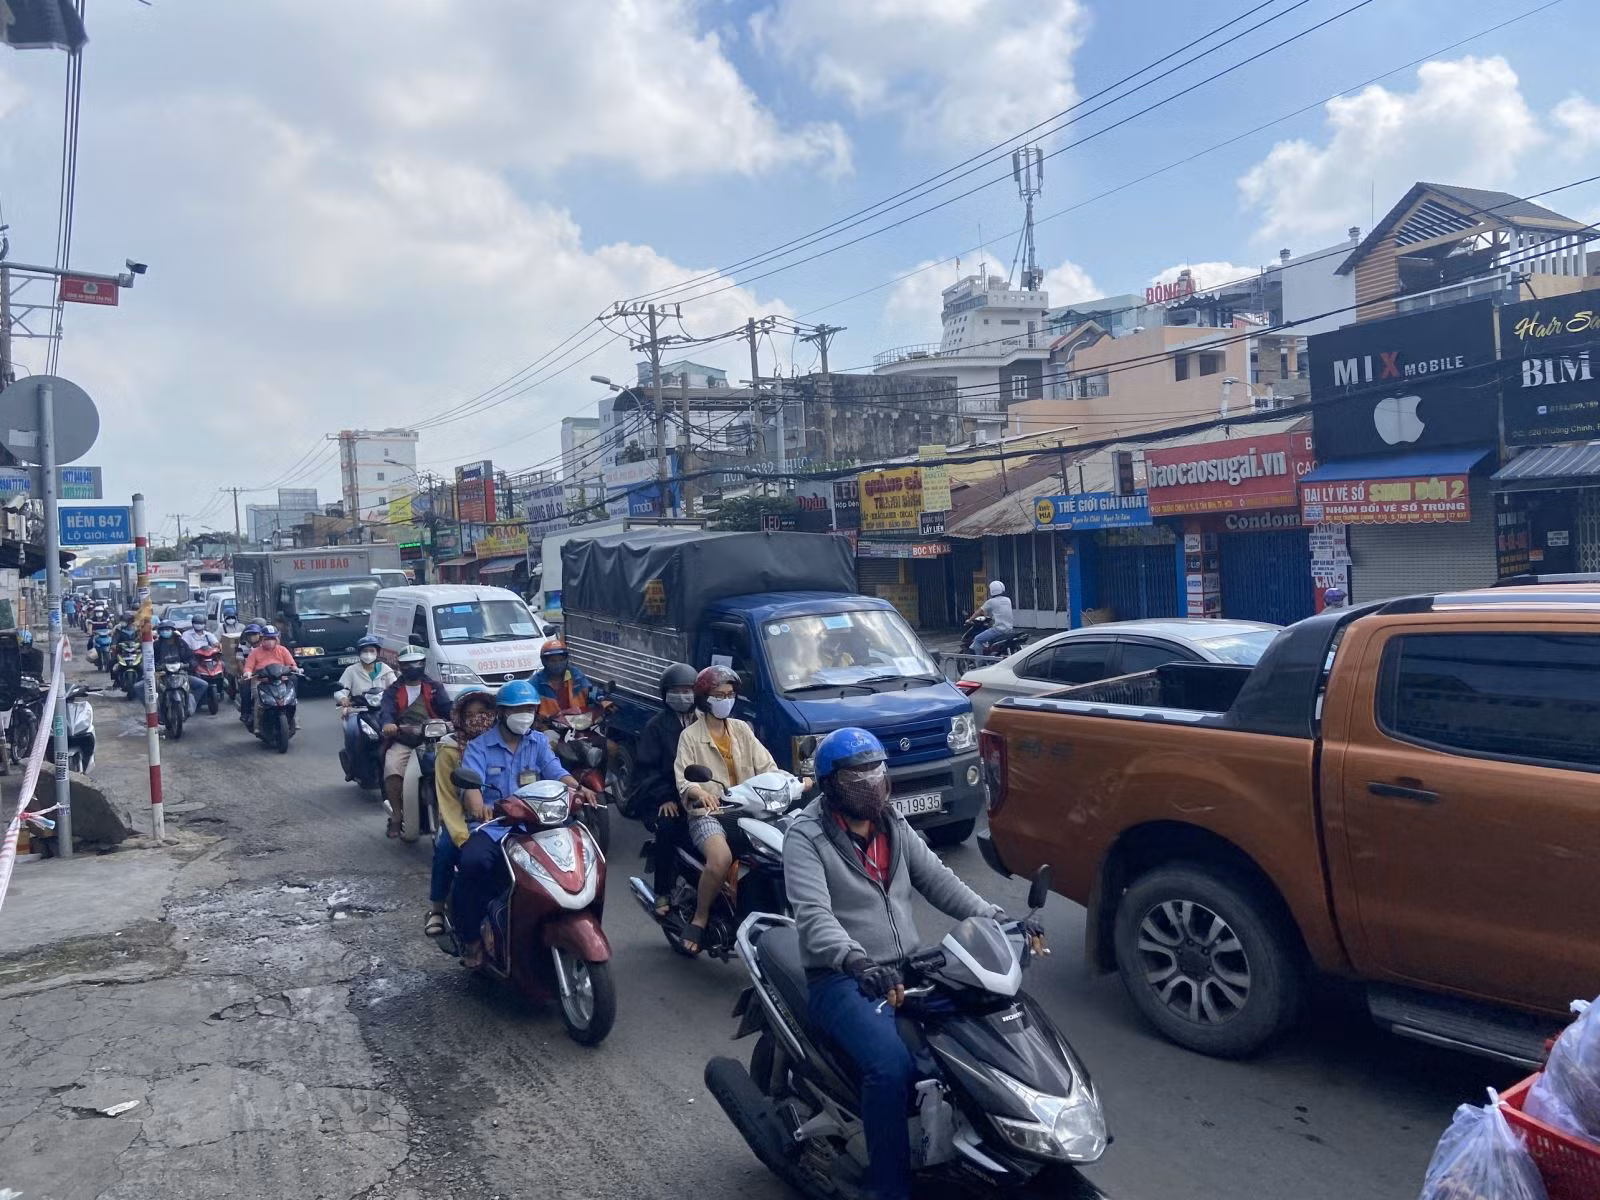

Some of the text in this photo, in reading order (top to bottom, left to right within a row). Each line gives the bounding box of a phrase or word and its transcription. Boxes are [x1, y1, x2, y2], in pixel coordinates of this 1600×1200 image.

[1513, 310, 1563, 341] Hair
[1333, 351, 1465, 387] MIX MOBILE
[1520, 350, 1595, 388] BIM
[1148, 446, 1287, 488] baocaosugai.vn
[834, 483, 858, 500] LED
[1451, 480, 1465, 499] 2
[1058, 496, 1077, 514] THẾ
[1078, 496, 1098, 512] GIỚI
[1325, 505, 1358, 515] NHẬN
[66, 511, 122, 528] HẺM 647
[1225, 511, 1301, 530] Condom
[110, 531, 124, 539] 4M
[293, 559, 306, 570] XE
[888, 794, 941, 814] D-199.35
